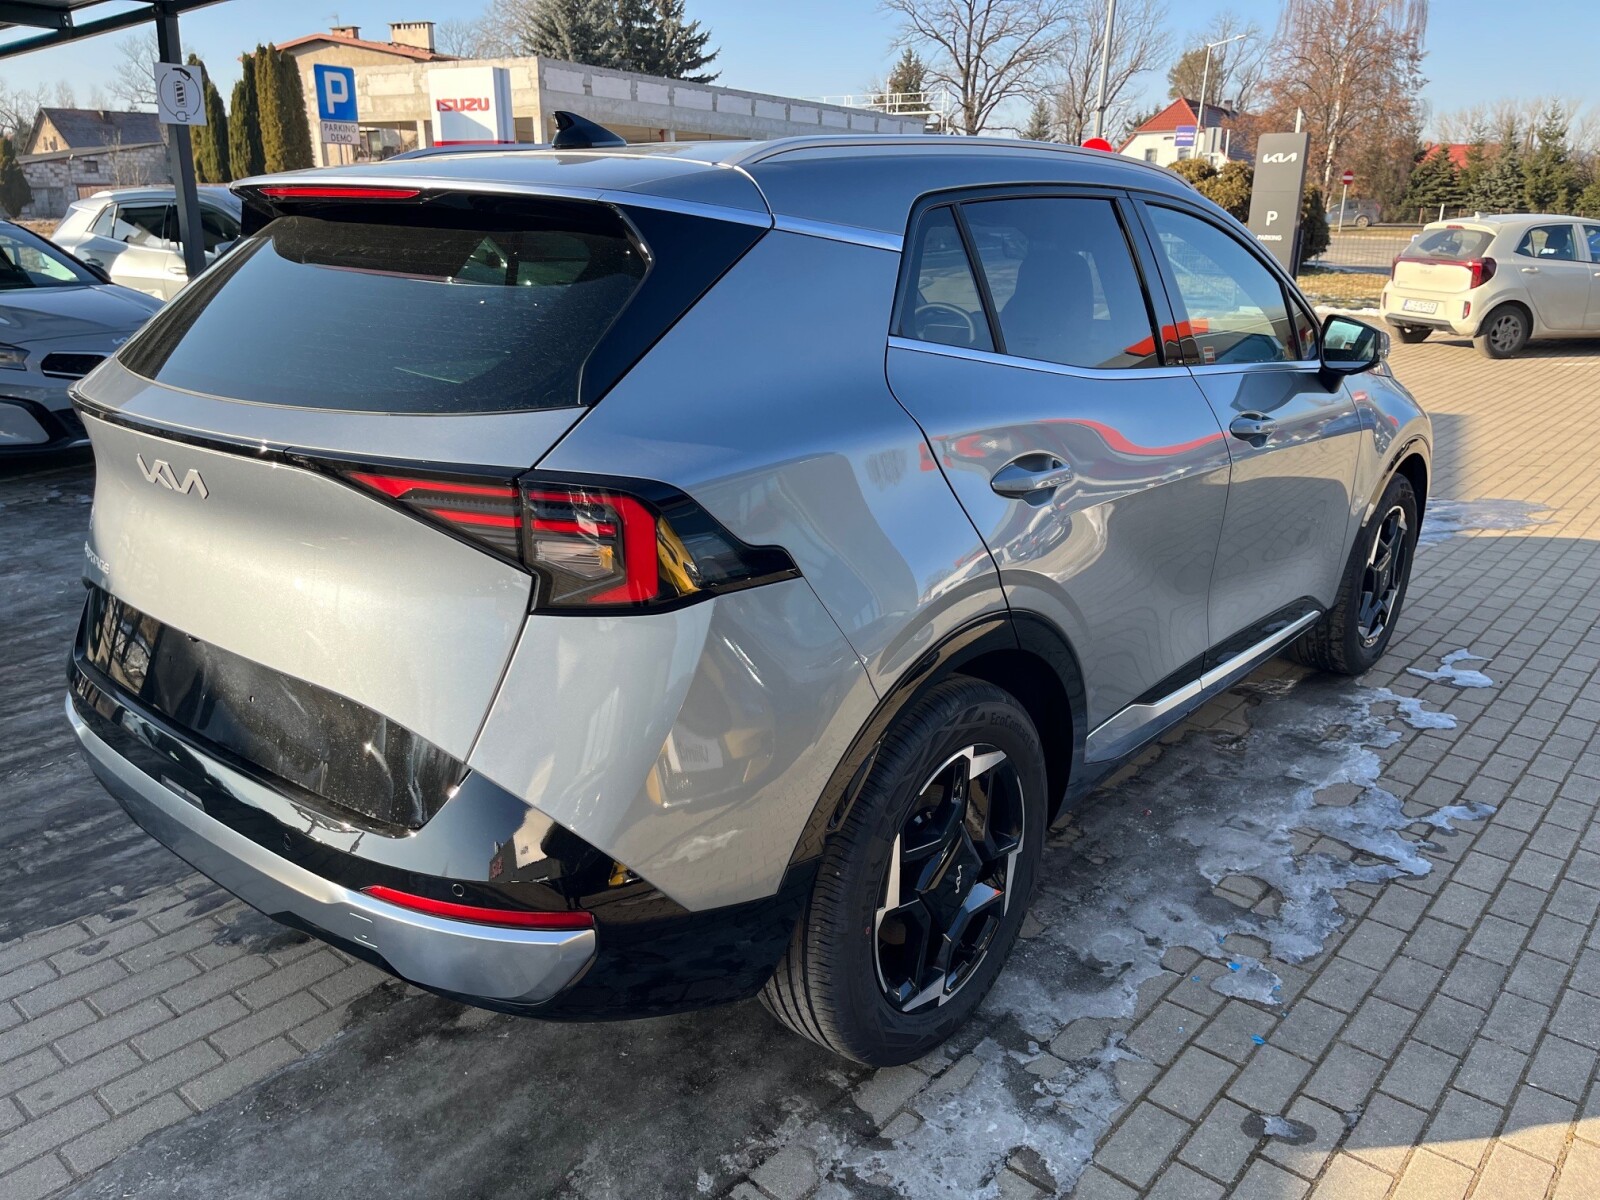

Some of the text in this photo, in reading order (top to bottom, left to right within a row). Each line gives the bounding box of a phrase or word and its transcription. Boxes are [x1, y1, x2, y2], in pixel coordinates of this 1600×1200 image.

[324, 71, 348, 114] P
[436, 97, 490, 112] ISUZU
[324, 123, 356, 133] PARKING
[330, 133, 353, 142] DEMO
[1265, 210, 1278, 226] P
[136, 453, 209, 499] KIA
